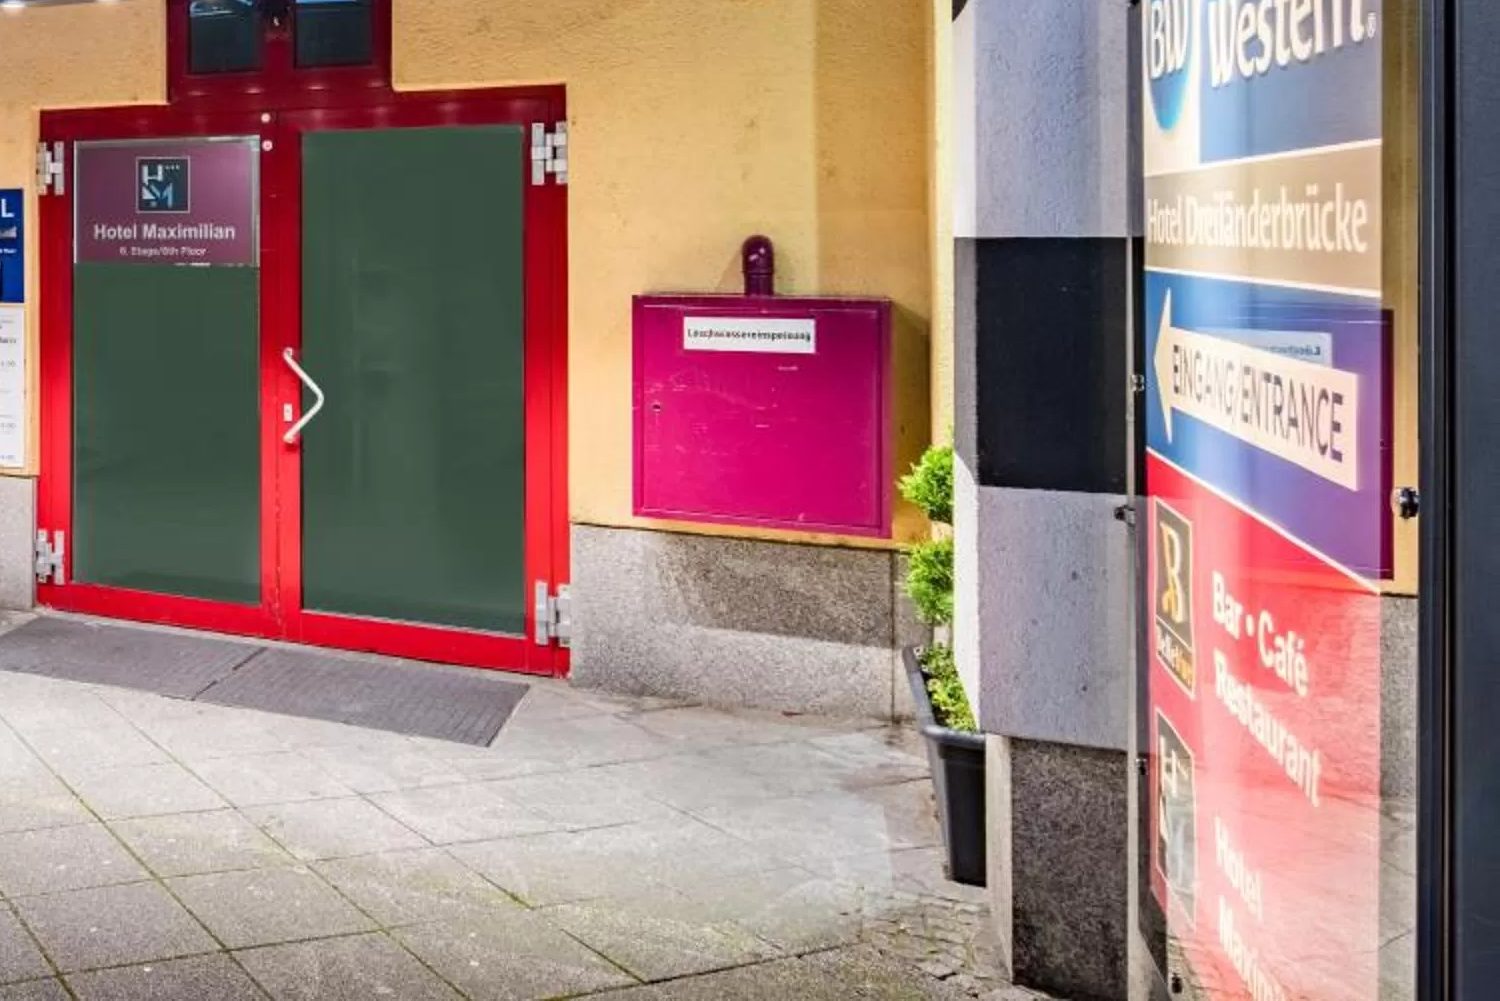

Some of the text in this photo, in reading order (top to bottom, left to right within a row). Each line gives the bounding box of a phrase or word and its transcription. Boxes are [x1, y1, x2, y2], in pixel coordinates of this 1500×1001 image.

[93, 222, 237, 241] Hotel Maximilian
[1147, 183, 1368, 253] Hotel Dreiländerbrücke
[1173, 344, 1344, 463] EINGANG/ENTRANCE
[1211, 570, 1243, 640] Bar
[1257, 610, 1310, 699] Café
[1214, 648, 1323, 808] Restaurant
[1215, 815, 1265, 921] Hotel
